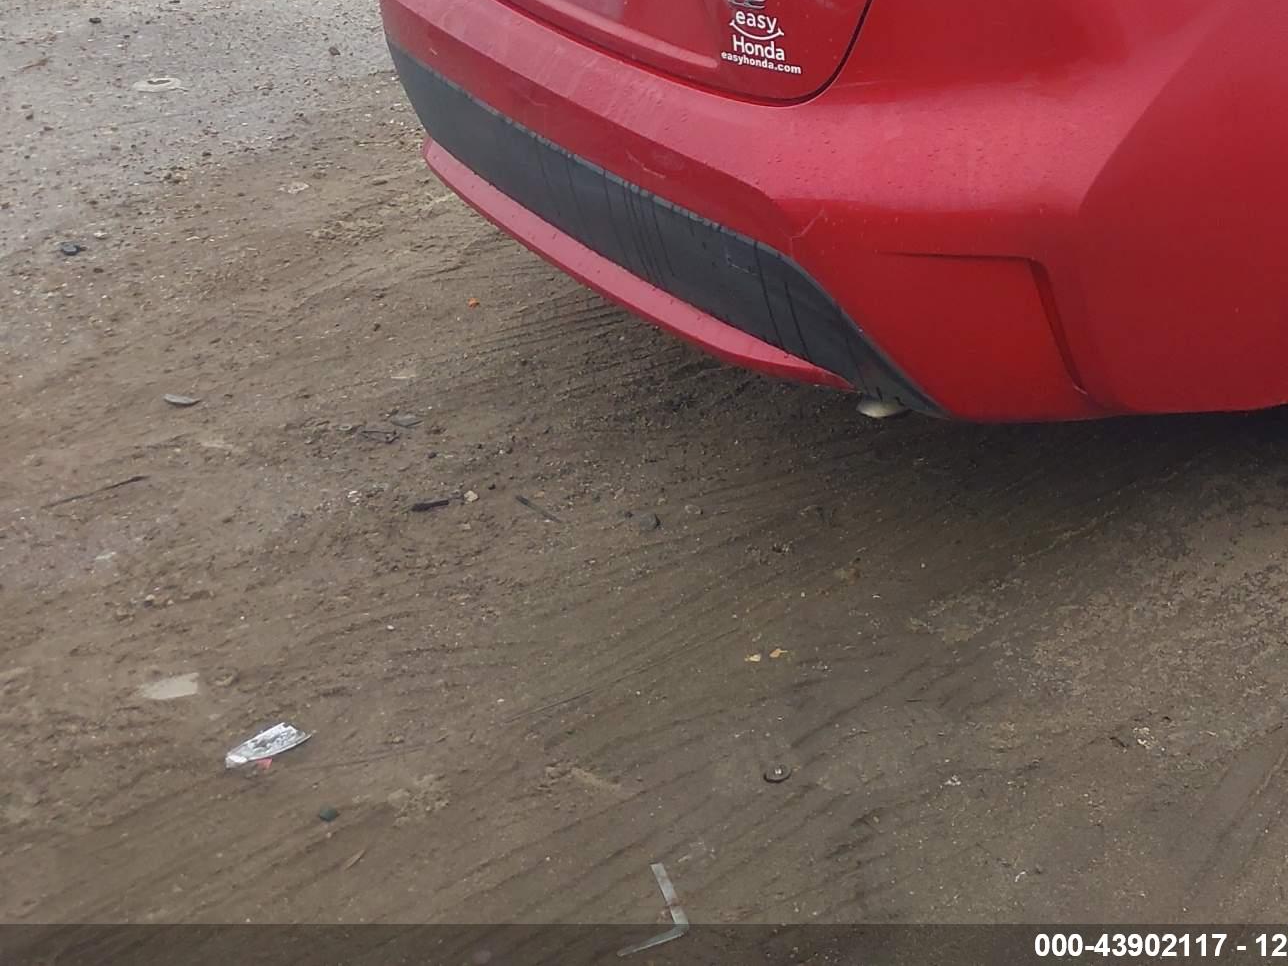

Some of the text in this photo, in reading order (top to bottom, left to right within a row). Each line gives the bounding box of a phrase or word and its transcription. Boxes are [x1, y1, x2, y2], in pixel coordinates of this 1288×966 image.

[735, 10, 777, 34] easy
[732, 34, 785, 61] Honda
[720, 51, 802, 75] easyhonda.com
